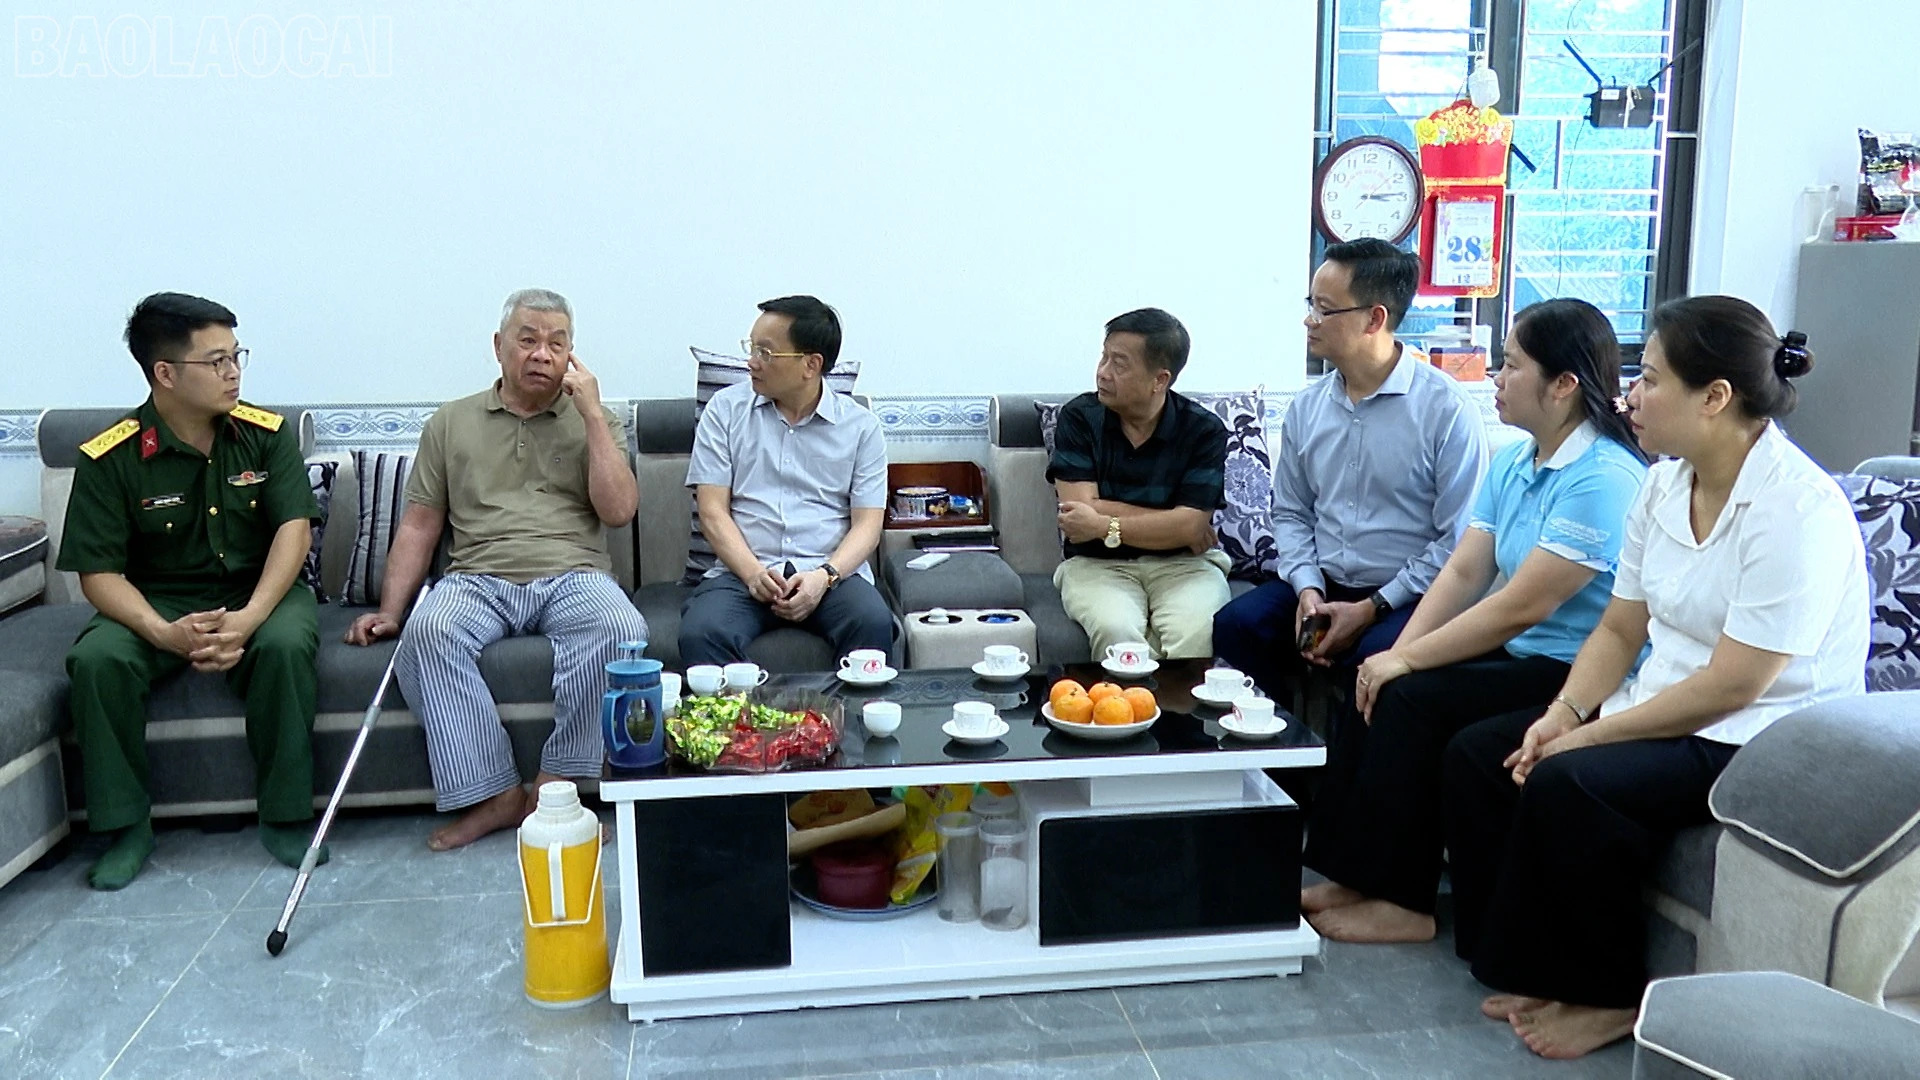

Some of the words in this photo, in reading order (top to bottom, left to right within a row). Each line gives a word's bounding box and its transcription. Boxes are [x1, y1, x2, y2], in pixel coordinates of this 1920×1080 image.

[1347, 159, 1357, 169] 11
[1363, 153, 1378, 164] 12
[1333, 173, 1347, 184] 10
[1392, 173, 1404, 184] 2
[1327, 191, 1338, 202] 9
[1396, 191, 1408, 202] 3
[1331, 209, 1342, 220] 8
[1390, 210, 1401, 220] 4
[1343, 223, 1353, 234] 7
[1377, 223, 1388, 234] 5
[1447, 235, 1482, 263] 28
